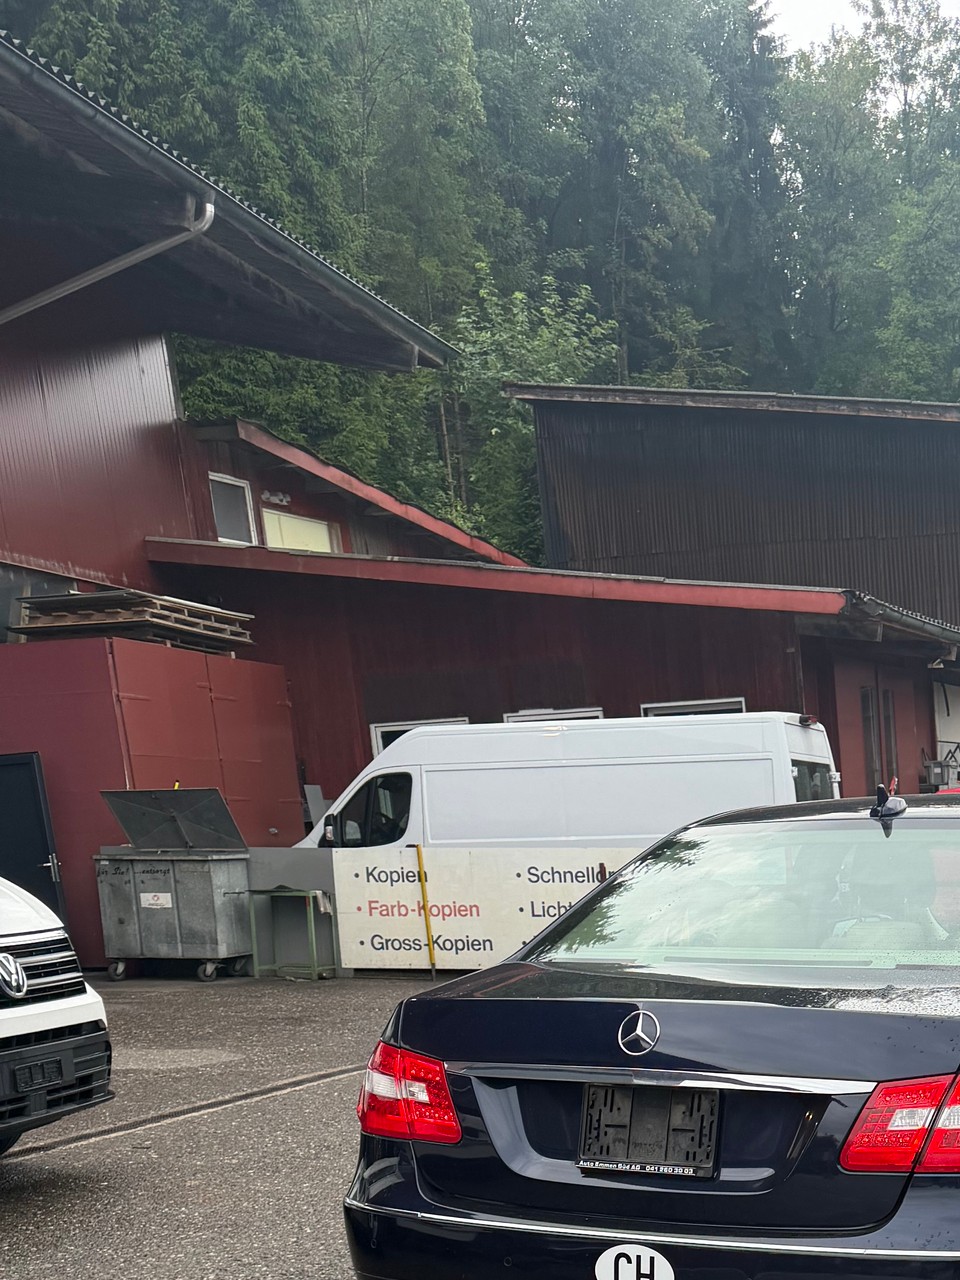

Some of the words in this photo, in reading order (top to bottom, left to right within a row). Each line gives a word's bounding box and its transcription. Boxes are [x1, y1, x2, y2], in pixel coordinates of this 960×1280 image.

[365, 866, 428, 887] Kopien
[367, 900, 480, 921] Farb-Kopien
[370, 934, 494, 955] Gross-Kopien
[595, 1161, 617, 1169] Emmen
[645, 1165, 658, 1173] 041
